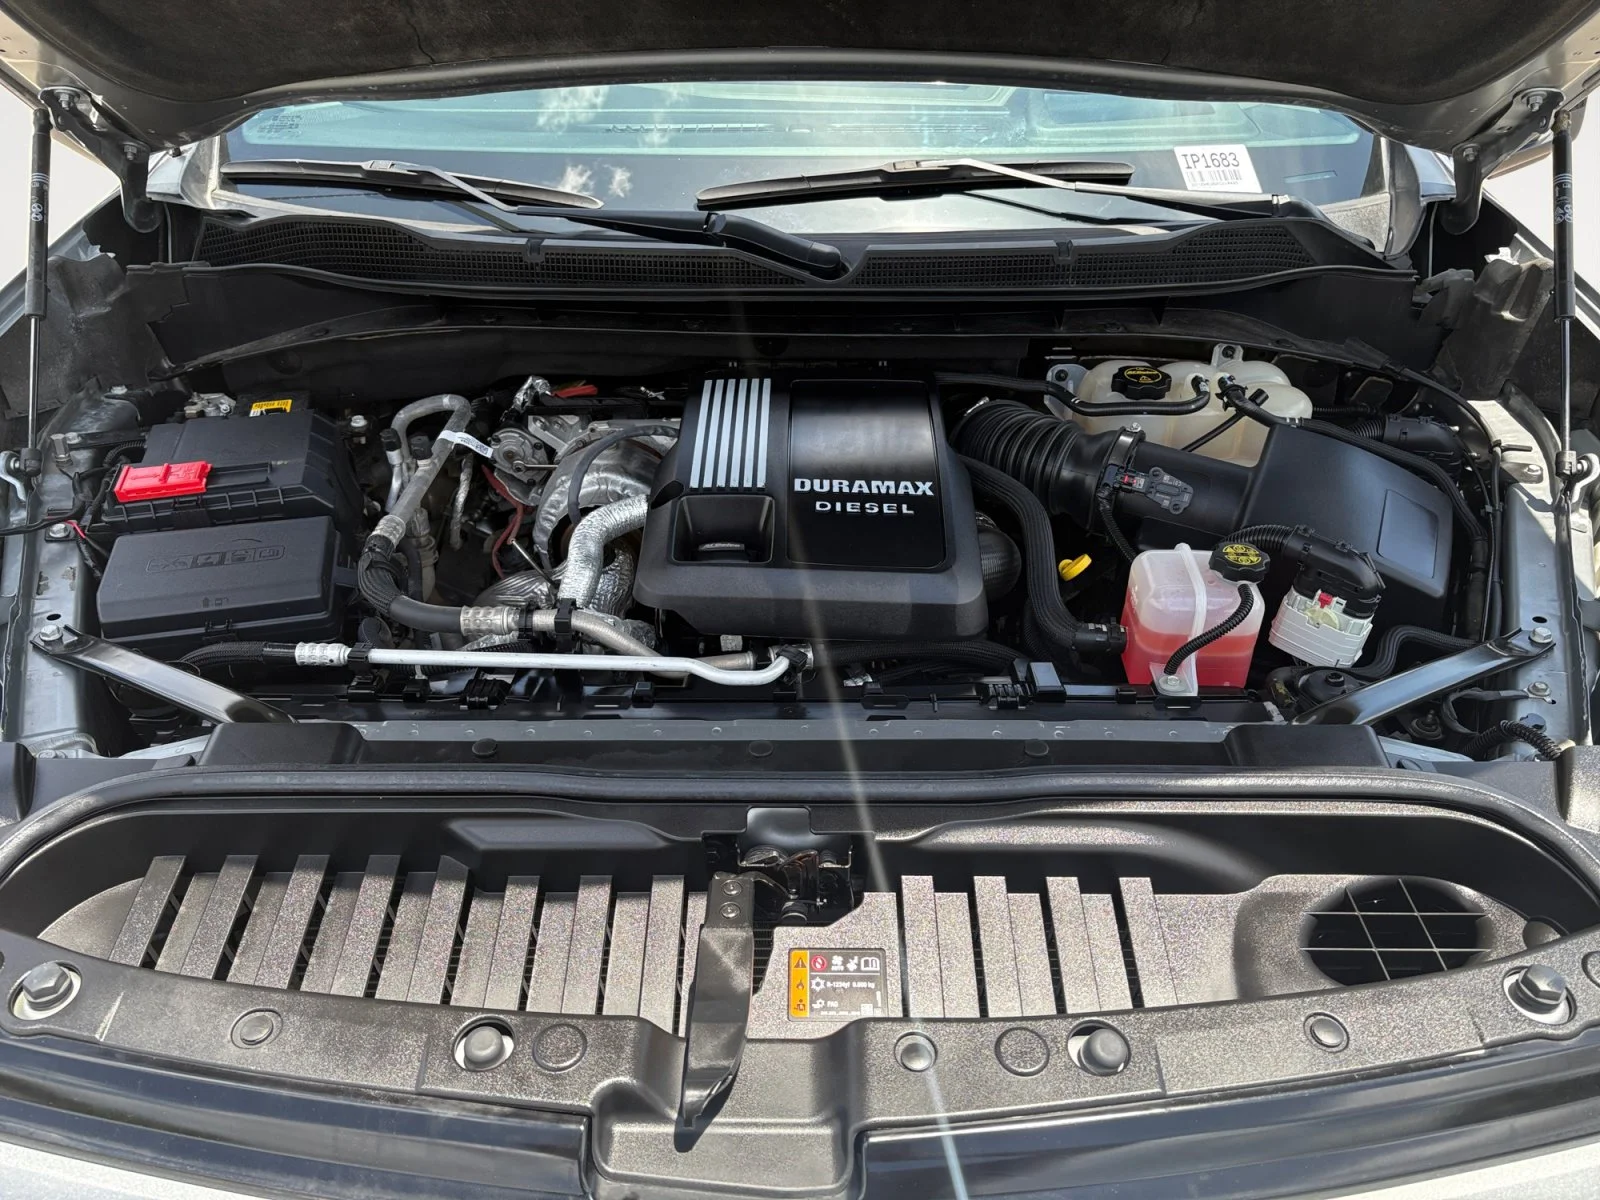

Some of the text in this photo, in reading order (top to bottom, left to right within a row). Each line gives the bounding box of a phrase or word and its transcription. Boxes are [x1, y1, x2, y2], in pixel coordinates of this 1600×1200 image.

[1181, 152, 1240, 169] IP1683
[793, 478, 935, 496] DURAMAX
[815, 501, 915, 515] DIESEL
